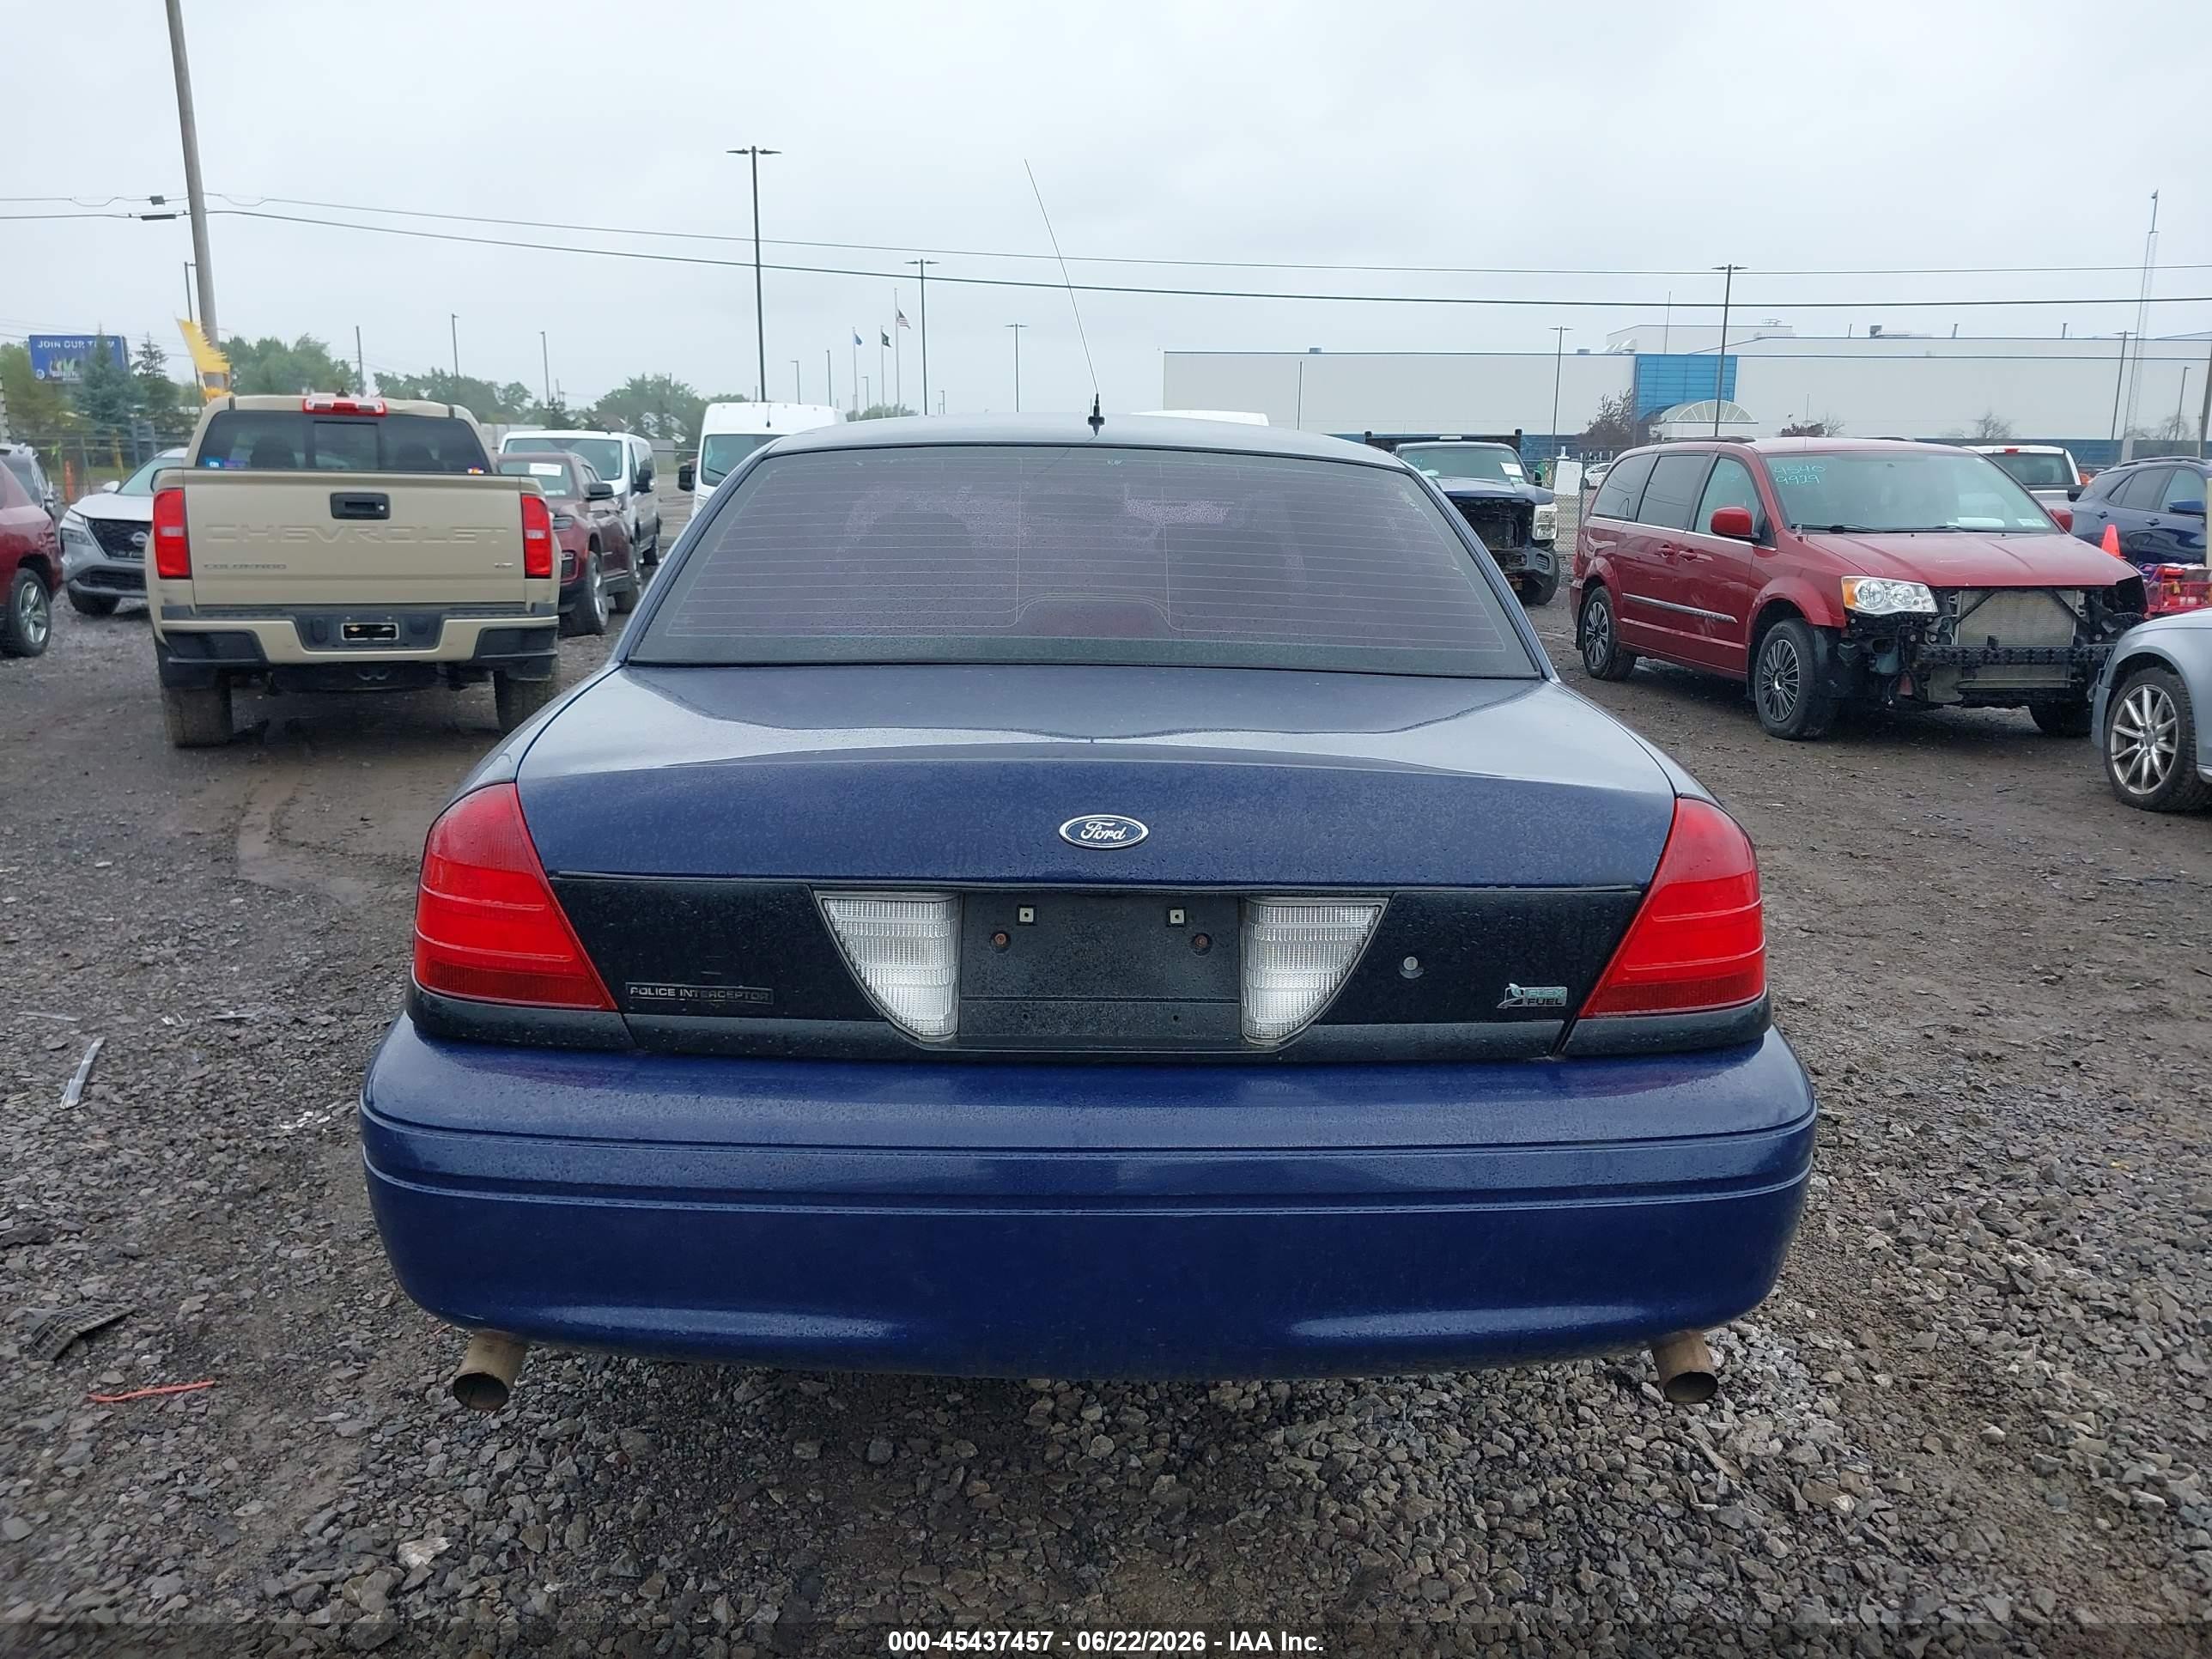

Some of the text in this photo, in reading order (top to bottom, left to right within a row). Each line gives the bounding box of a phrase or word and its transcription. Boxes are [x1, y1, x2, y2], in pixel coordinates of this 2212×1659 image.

[37, 340, 61, 349] JOIN
[64, 340, 85, 349] OUR
[1776, 474, 1820, 485] 9929
[205, 524, 508, 544] CHEVROLET
[1080, 821, 1127, 840] Ford
[630, 987, 769, 1000] POLICE INTERCEPTOR
